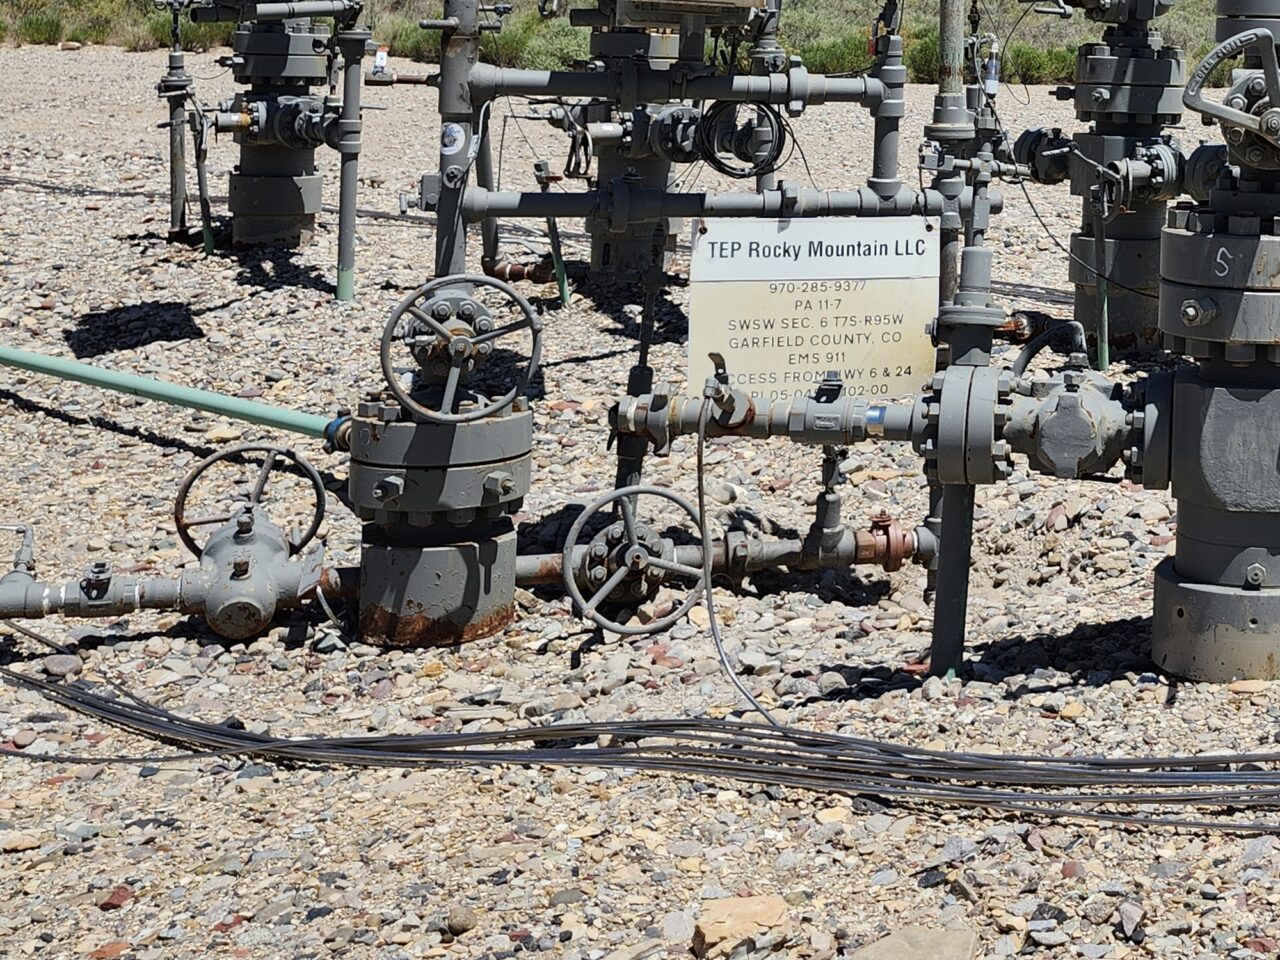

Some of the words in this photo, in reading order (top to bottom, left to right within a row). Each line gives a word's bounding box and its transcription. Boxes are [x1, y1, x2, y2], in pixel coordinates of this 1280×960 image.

[707, 241, 741, 259] TEP
[748, 241, 801, 261] Rocky
[808, 239, 888, 257] Mountain
[895, 239, 926, 256] LLC
[769, 280, 867, 294] 970-285-9377
[794, 299, 812, 311] PA
[818, 299, 842, 310] 11-7
[728, 318, 776, 331] SWSW
[781, 317, 814, 329] SEC.
[820, 317, 829, 328] 6
[833, 313, 904, 328] T7S-R95W
[729, 335, 804, 349] GARFIELD
[810, 332, 875, 345] COUNTY,
[881, 332, 902, 343] CO
[788, 353, 820, 365] EMS
[826, 351, 845, 363] 911
[727, 372, 777, 385] CCESS
[784, 370, 826, 384] FROM
[838, 368, 865, 381] WY
[869, 366, 877, 378] 6
[881, 366, 891, 377] &
[895, 365, 912, 377] 24
